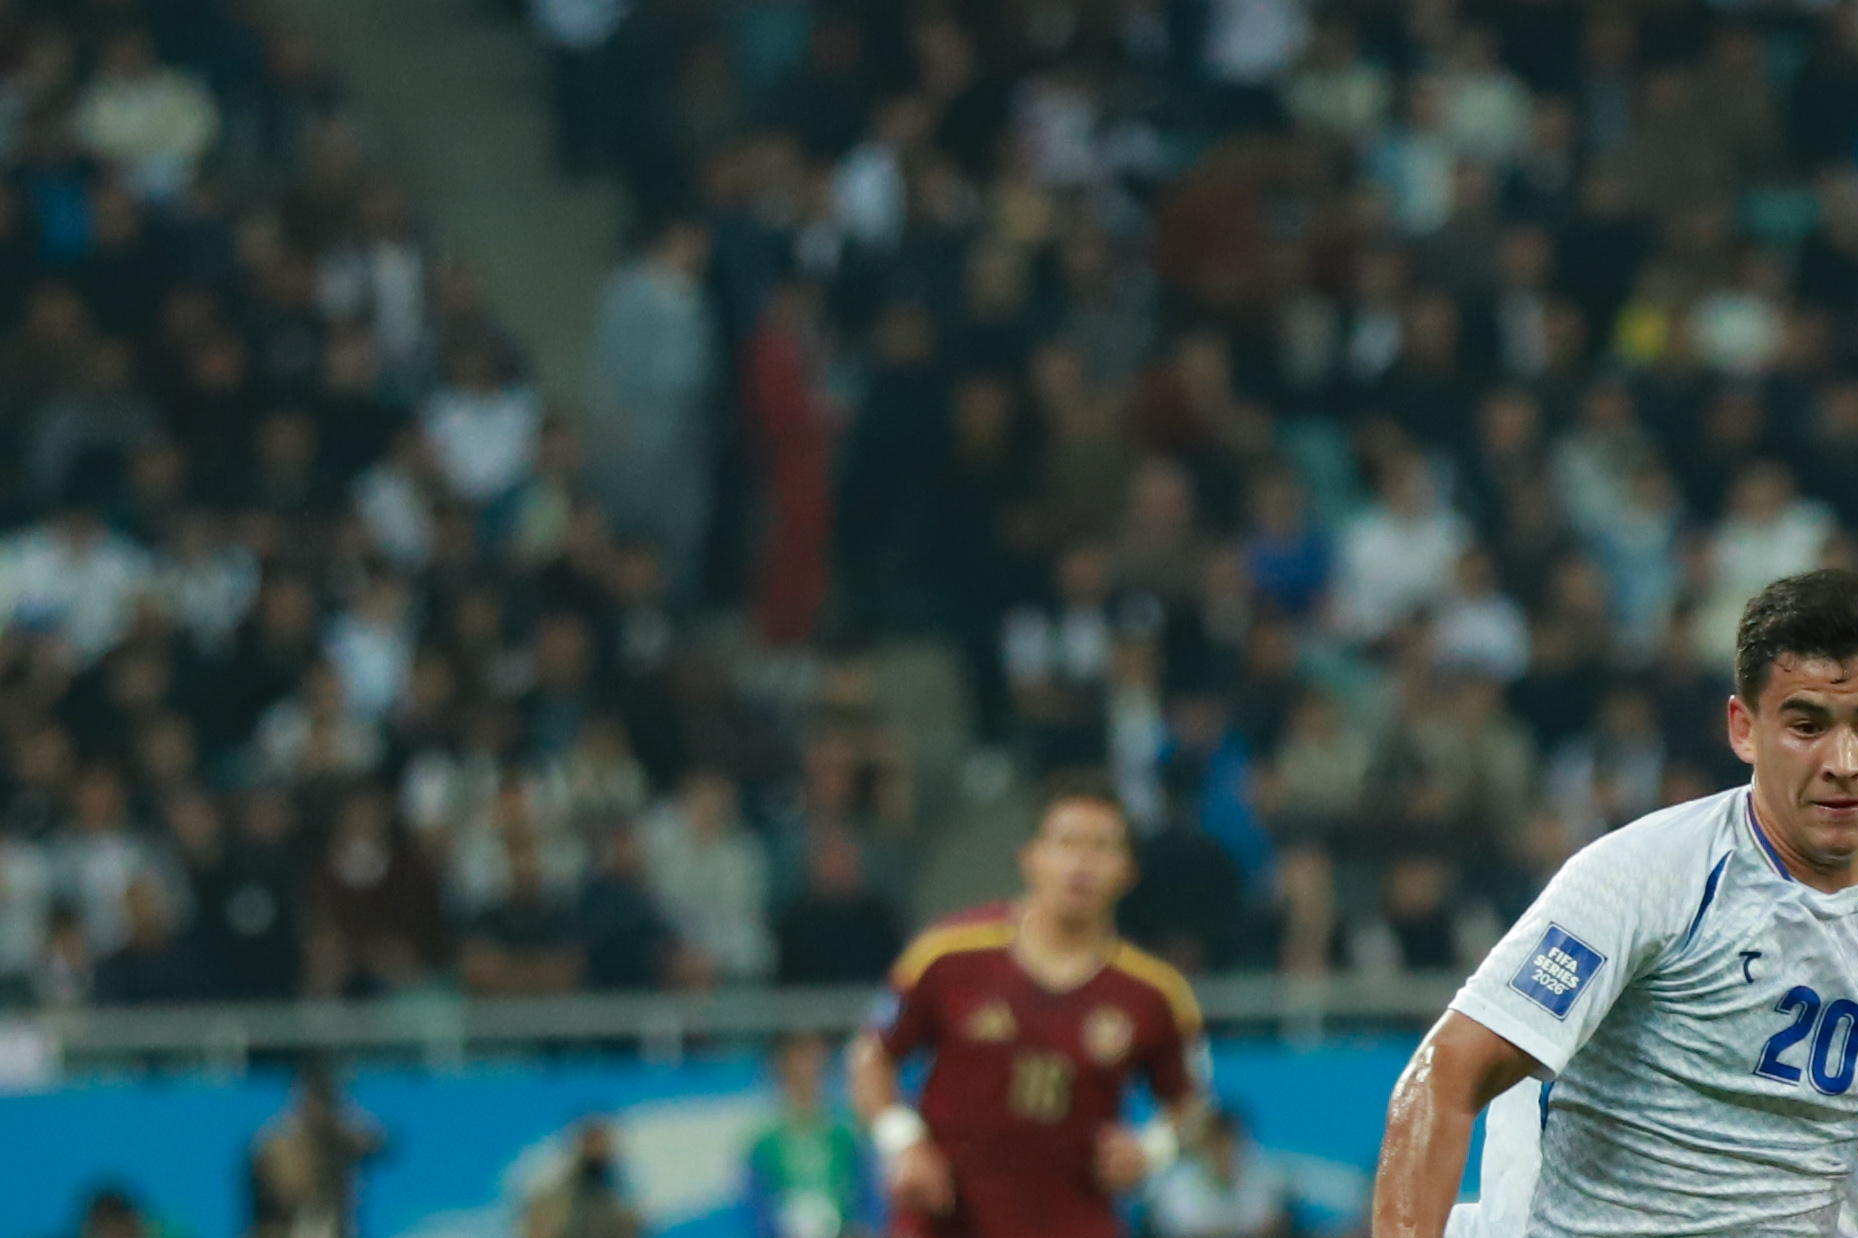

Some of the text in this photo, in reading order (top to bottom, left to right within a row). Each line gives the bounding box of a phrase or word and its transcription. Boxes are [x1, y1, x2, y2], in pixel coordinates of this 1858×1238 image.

[1533, 954, 1580, 989] SERIES
[1548, 946, 1579, 973] FIFA
[1531, 969, 1569, 995] 2026
